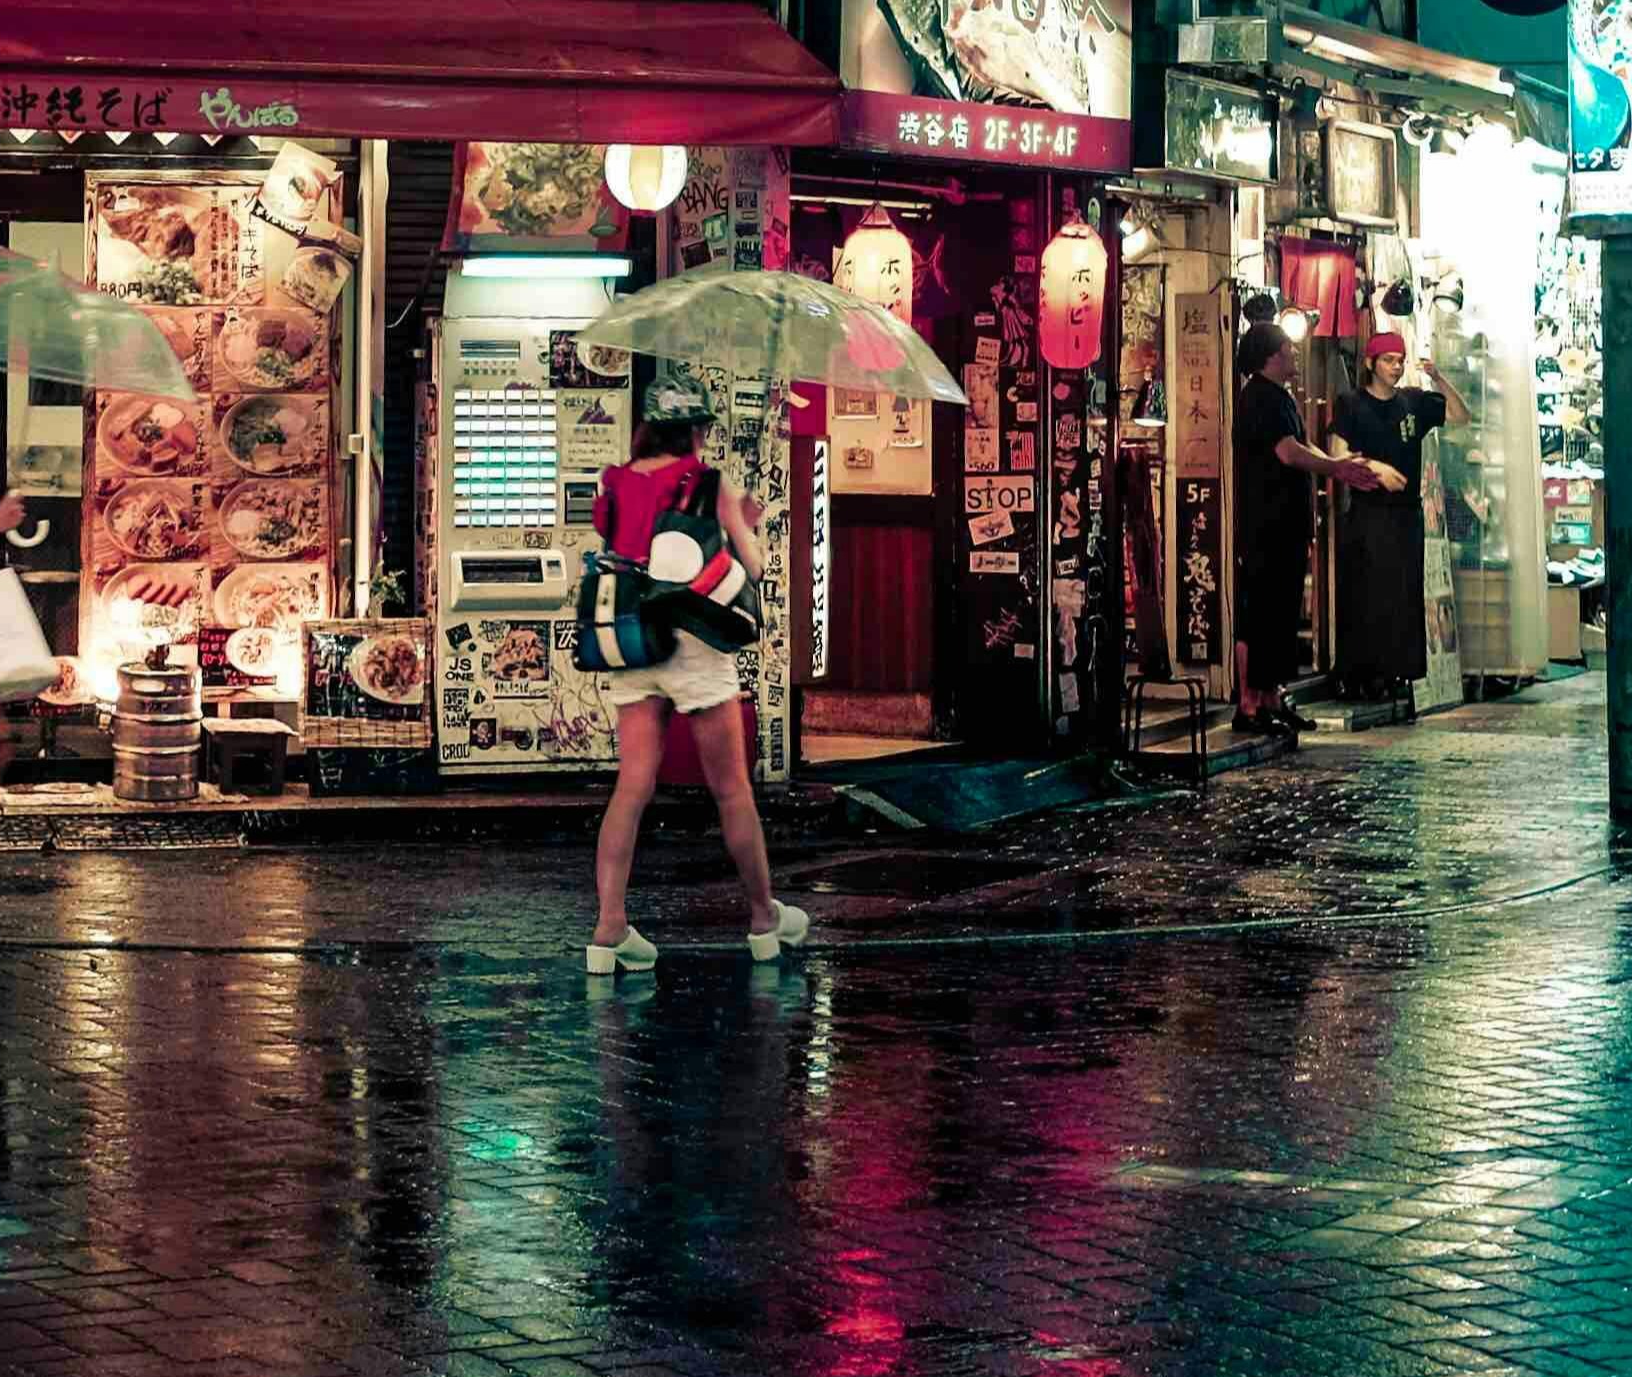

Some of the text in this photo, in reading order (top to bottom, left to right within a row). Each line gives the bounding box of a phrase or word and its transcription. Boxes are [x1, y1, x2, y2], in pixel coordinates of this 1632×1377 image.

[1, 83, 299, 128] 沖縄そば やんばる
[898, 112, 968, 149] 渋谷店
[1070, 269, 1090, 350] ホッピー
[1186, 483, 1211, 503] 5F
[449, 658, 472, 671] JS
